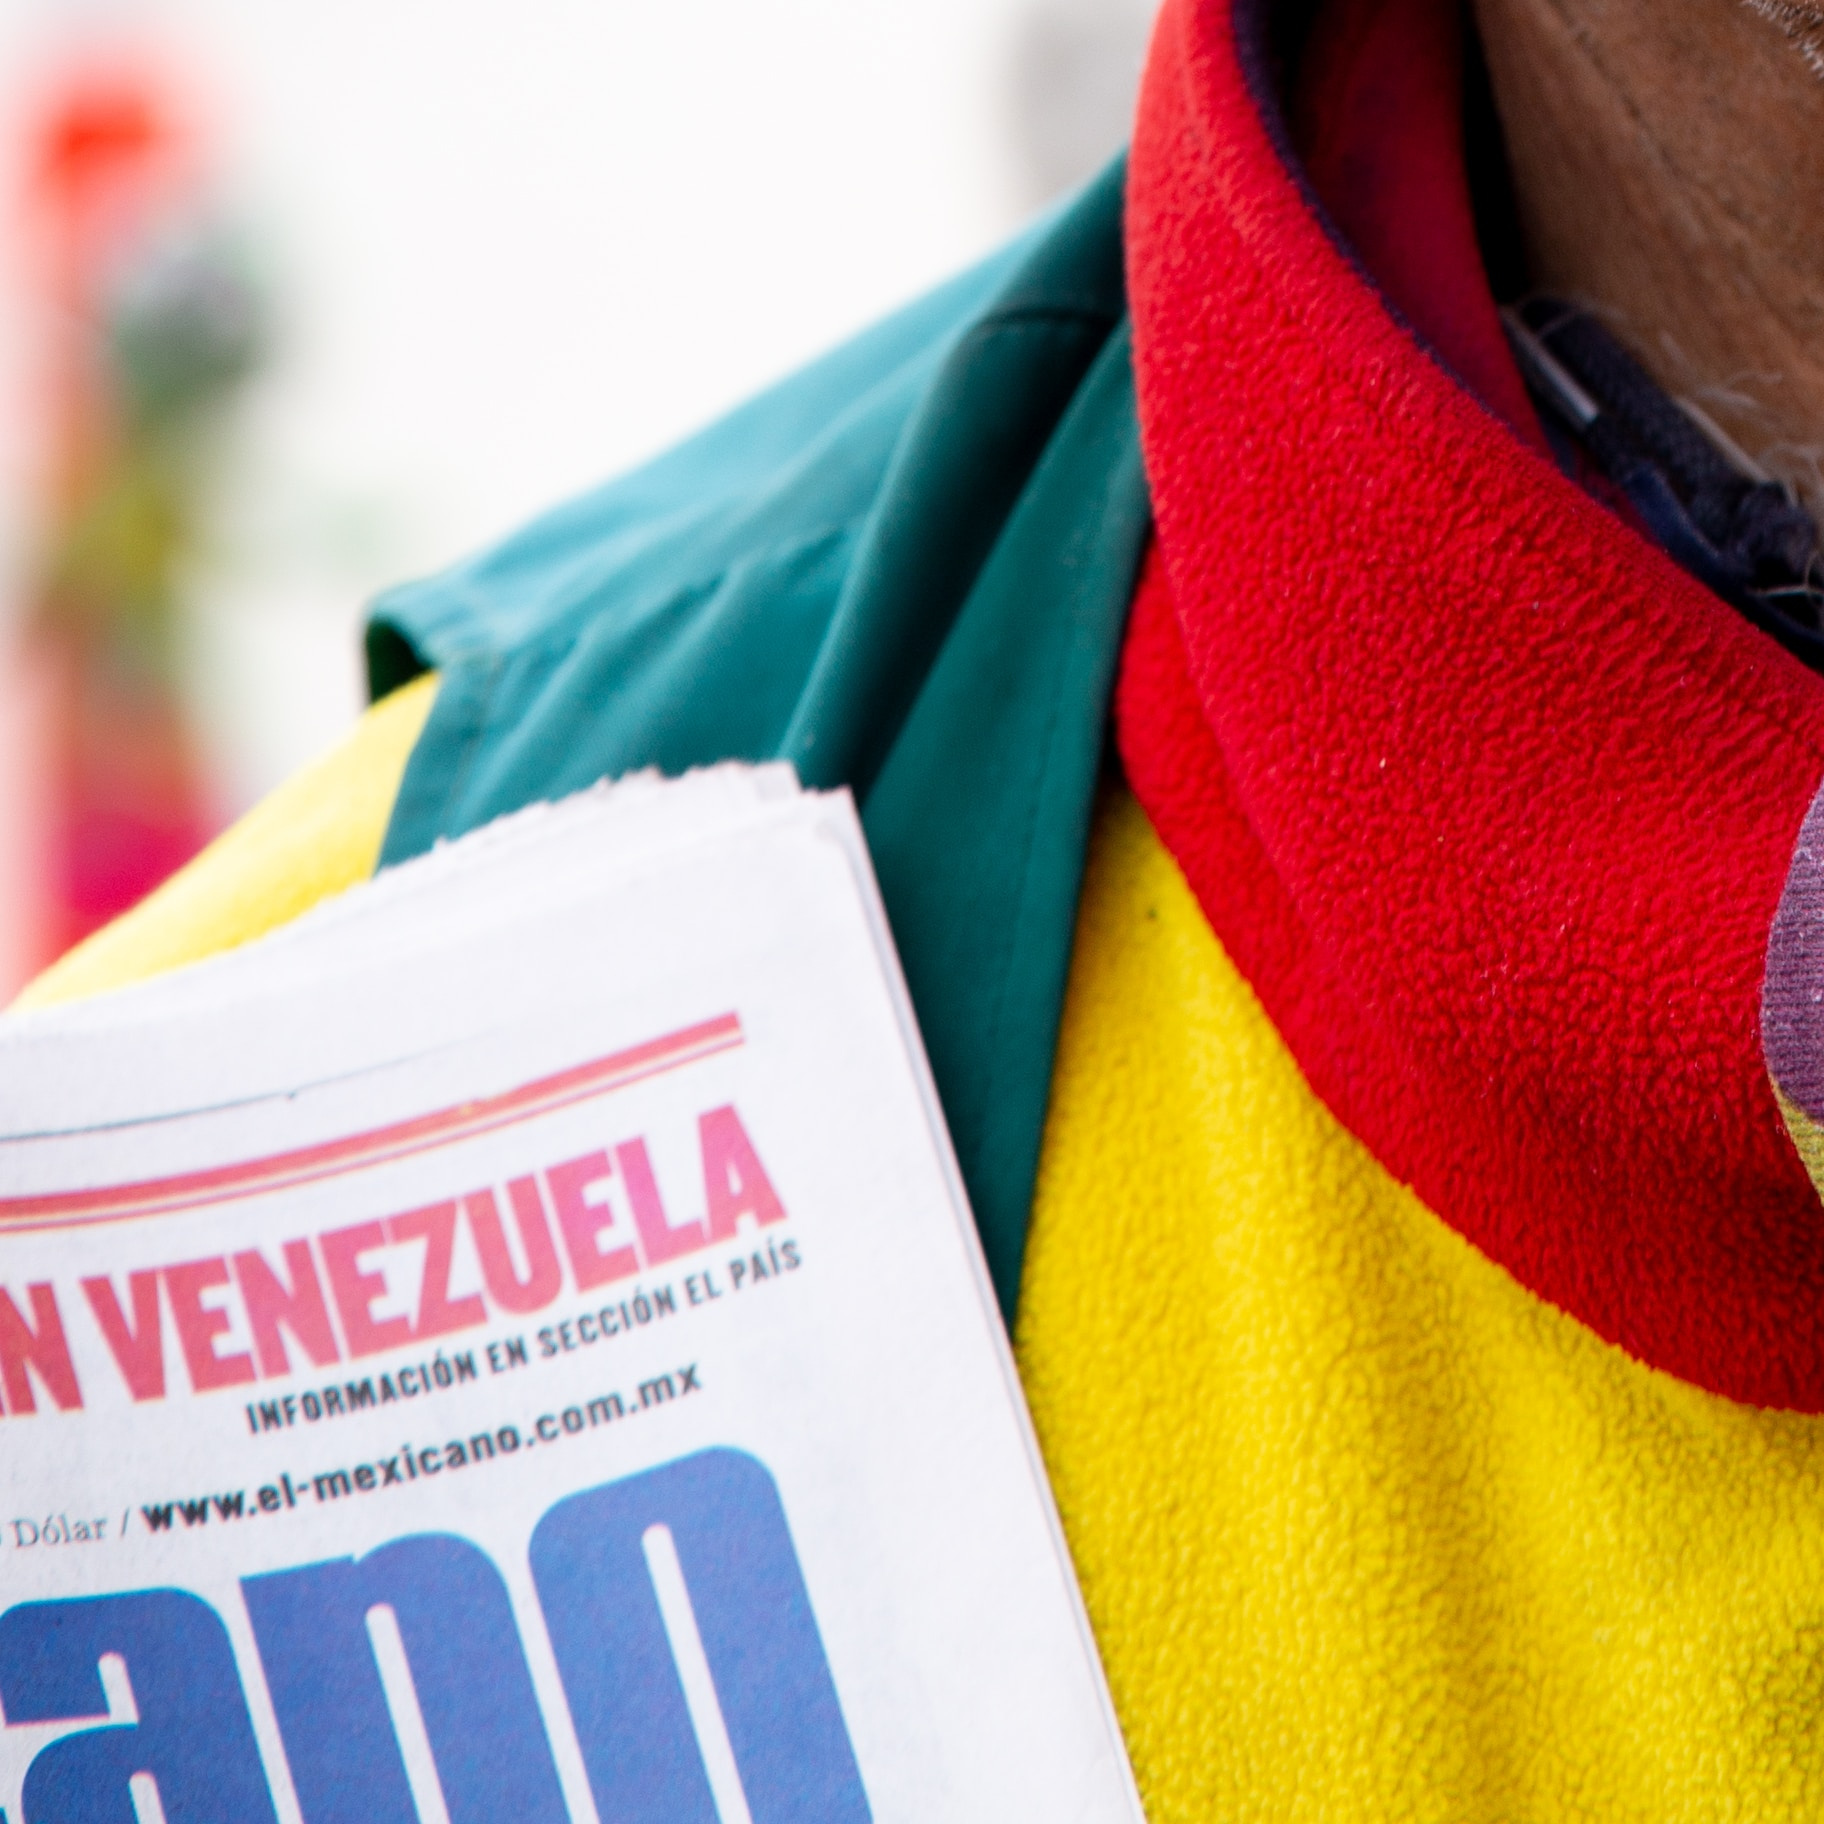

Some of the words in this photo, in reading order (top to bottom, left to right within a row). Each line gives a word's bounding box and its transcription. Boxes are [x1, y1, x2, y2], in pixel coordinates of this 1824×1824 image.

[0, 1279, 85, 1418] N
[79, 1104, 787, 1402] VENEZUELA
[245, 1345, 479, 1434] INFORMACIÓN
[486, 1337, 529, 1376] EN
[538, 1284, 677, 1358] SECCIÓN
[683, 1274, 724, 1307] EL
[729, 1237, 803, 1291] PAÍS
[9, 1513, 107, 1549] Dólar
[140, 1362, 703, 1533] www.el-mexicano.com.mx
[0, 1444, 875, 1824] ano
